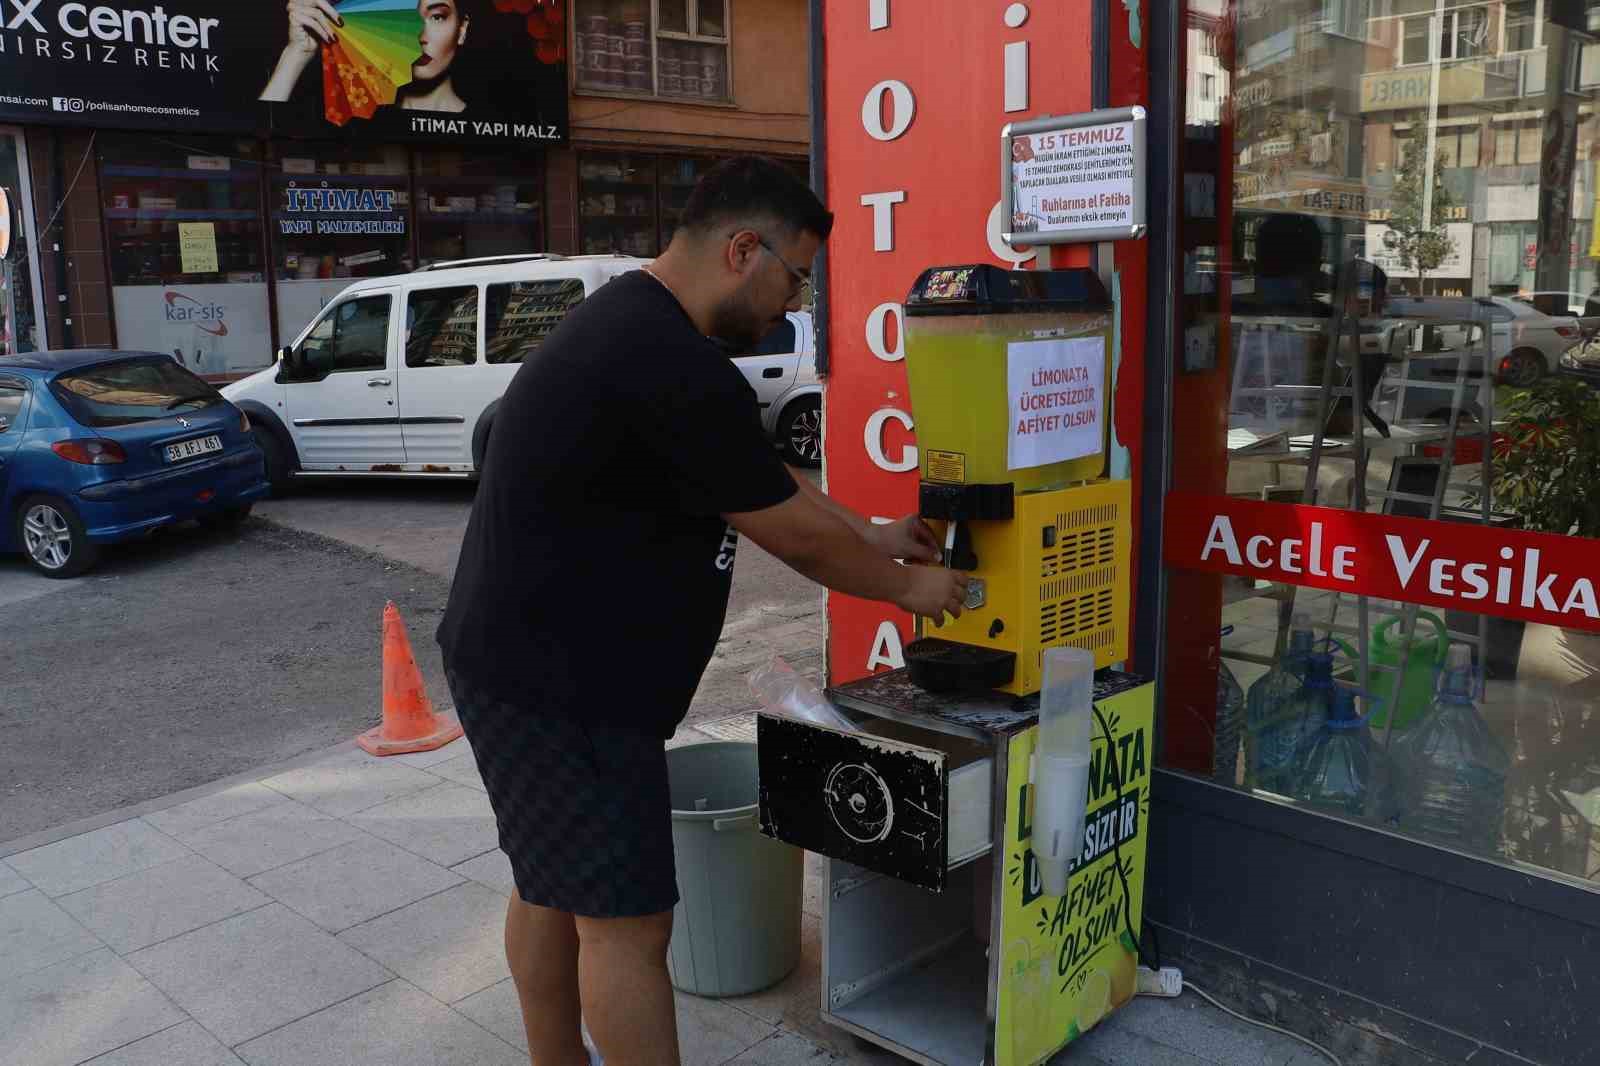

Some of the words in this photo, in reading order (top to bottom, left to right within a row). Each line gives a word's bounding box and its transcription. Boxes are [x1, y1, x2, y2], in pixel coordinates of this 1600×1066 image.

[0, 0, 48, 33] x
[58, 3, 219, 49] center
[135, 48, 220, 72] RENK
[472, 121, 508, 137] YAPI
[513, 124, 561, 139] MALZ.
[1038, 136, 1055, 150] 15
[1060, 127, 1124, 147] TEMMUZ
[1032, 165, 1052, 175] TEMMUZ
[1088, 195, 1098, 208] el
[166, 303, 225, 321] kar-sis
[1031, 366, 1089, 387] LİMONATA
[1020, 387, 1096, 412] ÜCRETSİZDİR
[1017, 414, 1060, 435] AFİYET
[1063, 409, 1096, 428] OLSUN
[168, 445, 181, 459] 58
[205, 436, 221, 449] 461
[1201, 515, 1356, 581] Acele
[1058, 893, 1123, 976] OLSUN
